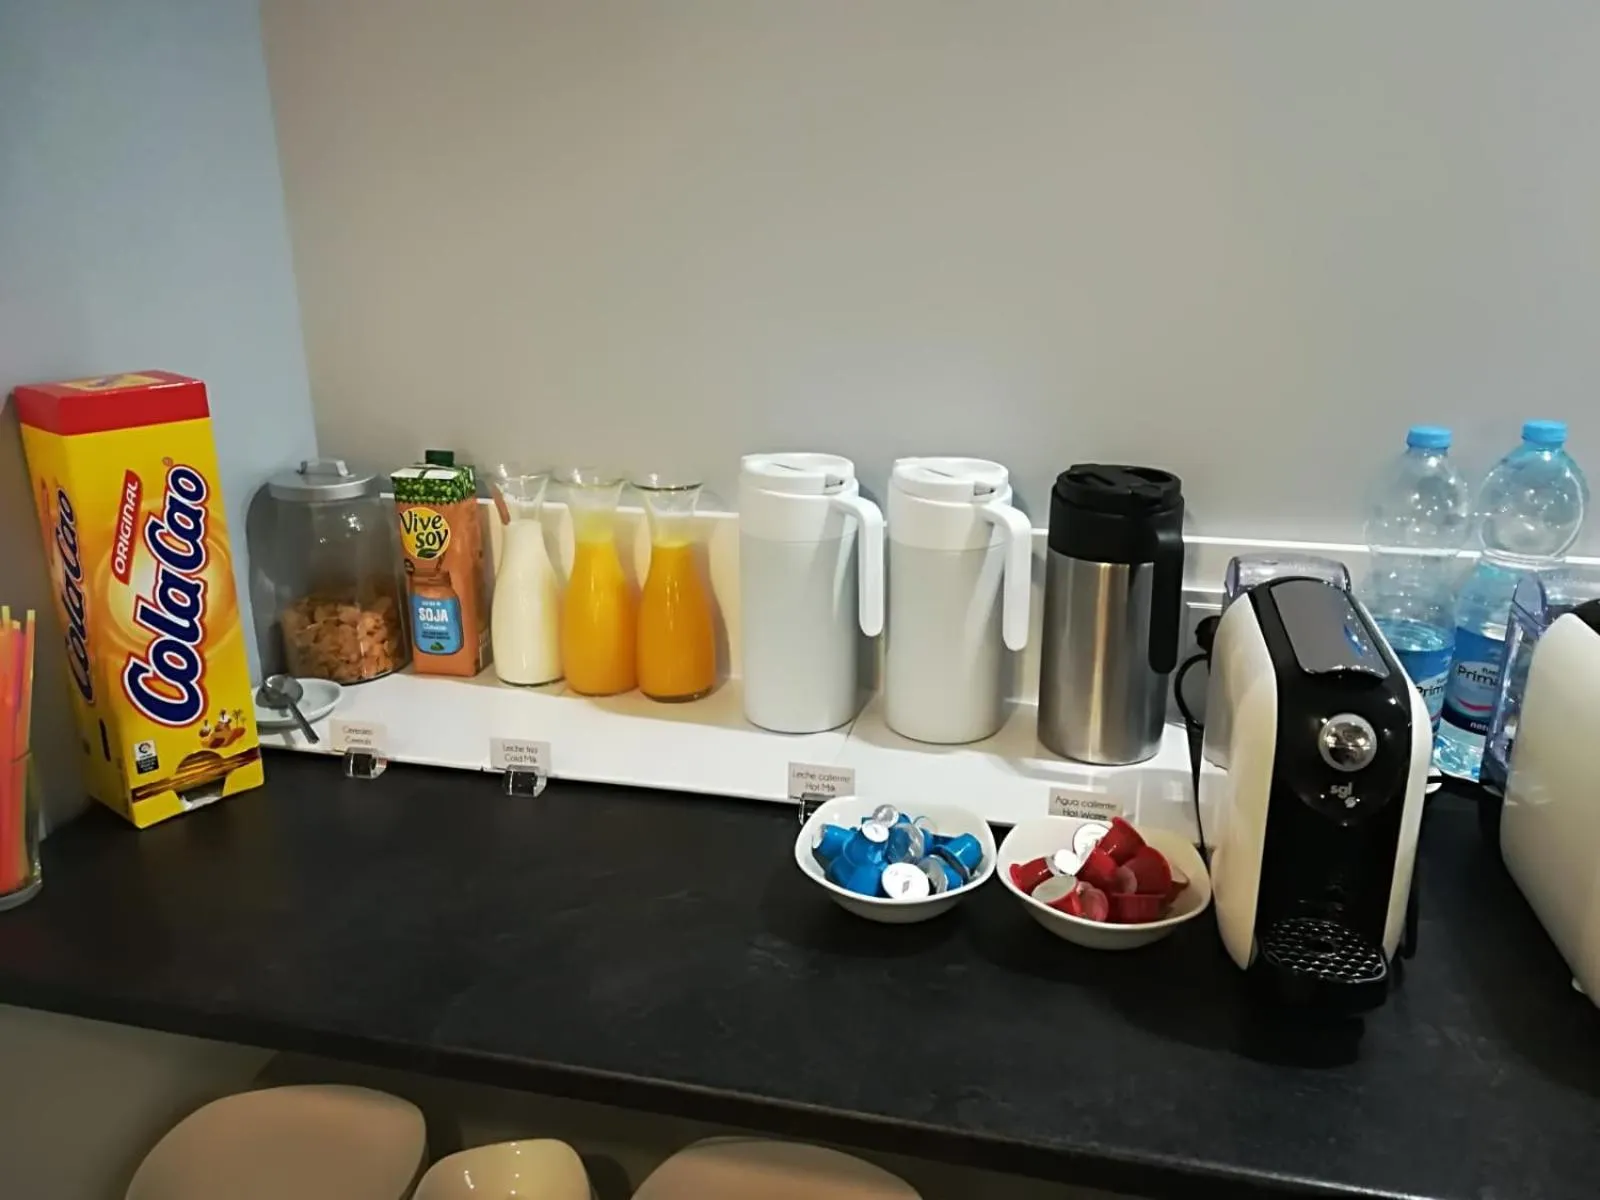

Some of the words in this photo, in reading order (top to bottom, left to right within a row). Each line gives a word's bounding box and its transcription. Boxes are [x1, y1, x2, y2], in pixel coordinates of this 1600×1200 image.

[114, 480, 139, 575] ORIGINAL
[398, 510, 443, 535] Vive
[415, 528, 449, 552] soy
[418, 607, 449, 622] SOJA
